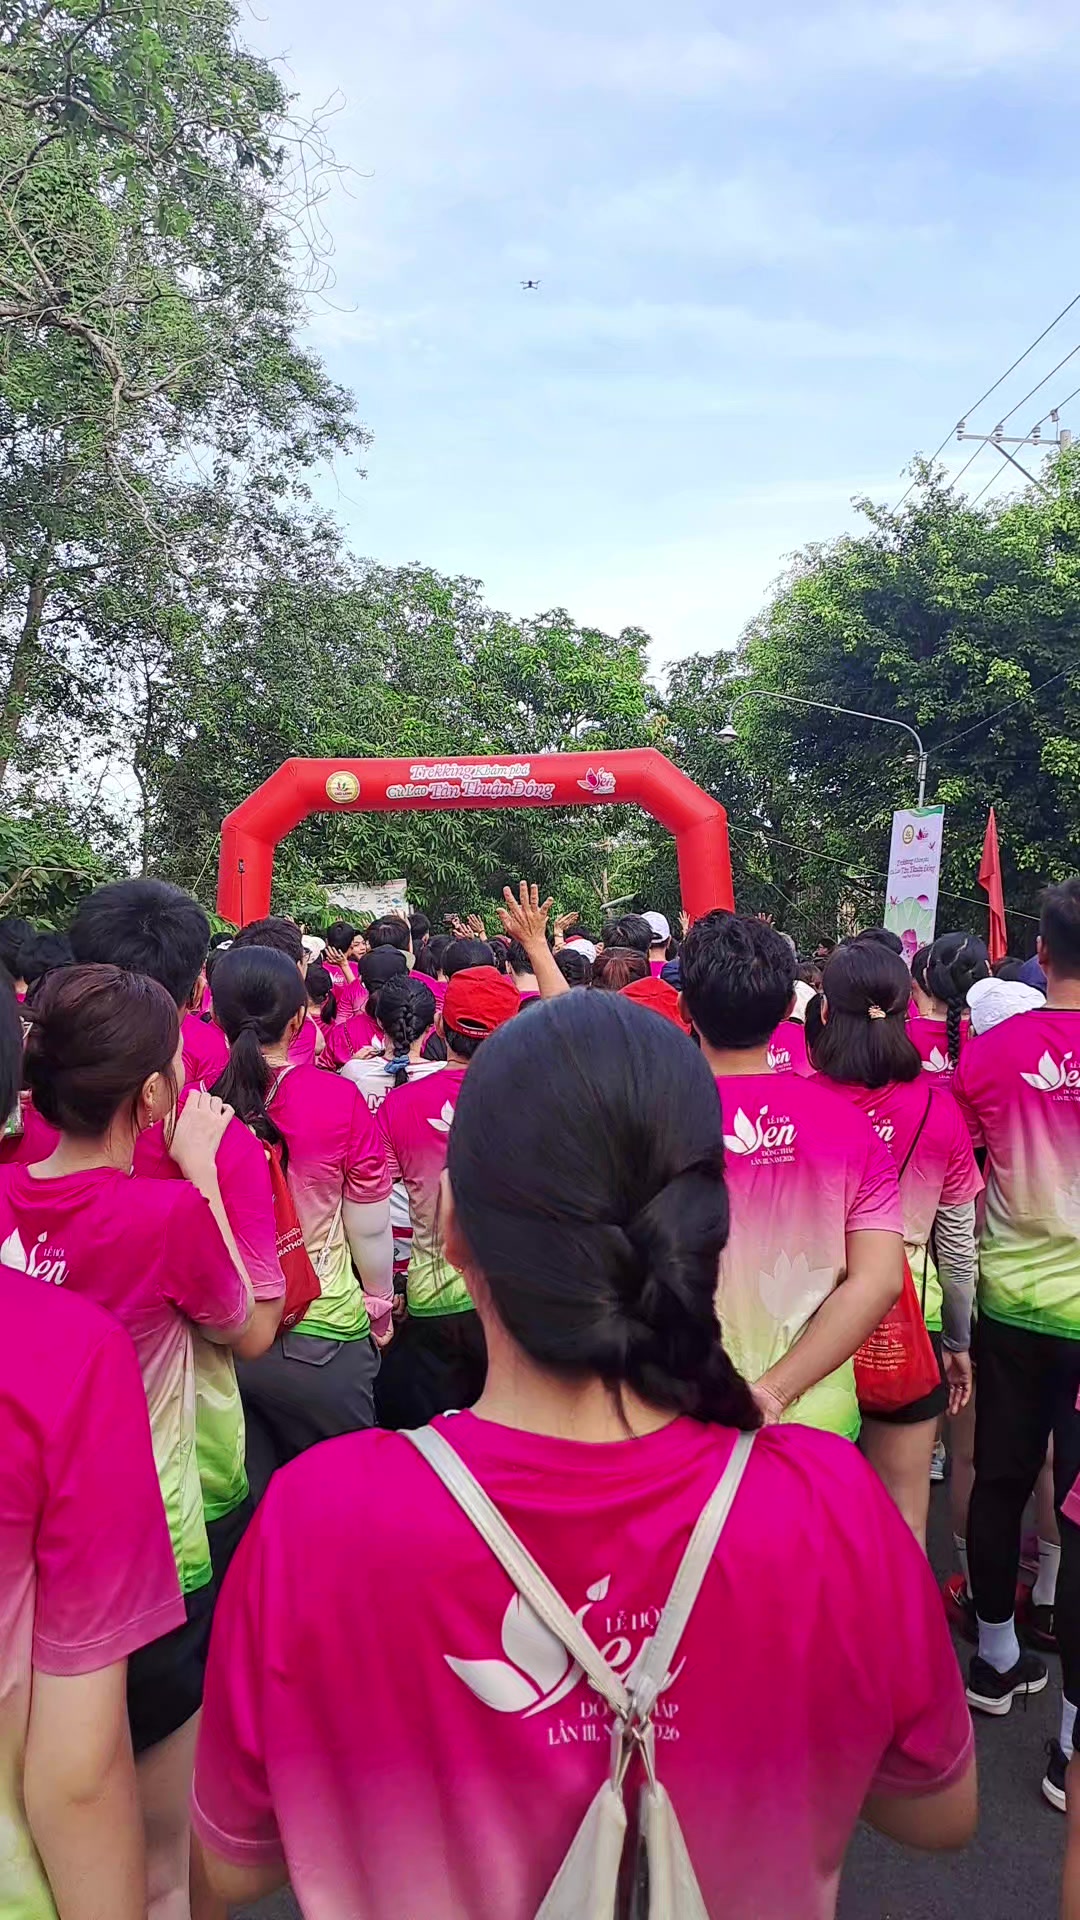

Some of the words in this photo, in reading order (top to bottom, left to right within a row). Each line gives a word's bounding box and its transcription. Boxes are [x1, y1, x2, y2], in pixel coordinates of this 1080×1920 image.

[411, 764, 473, 780] Trekking
[388, 785, 406, 798] Cù
[406, 785, 427, 797] Lao
[277, 1238, 304, 1258] RATHO
[606, 1610, 627, 1633] LỄ
[632, 1605, 664, 1631] HỘ
[548, 1719, 578, 1746] LẦN
